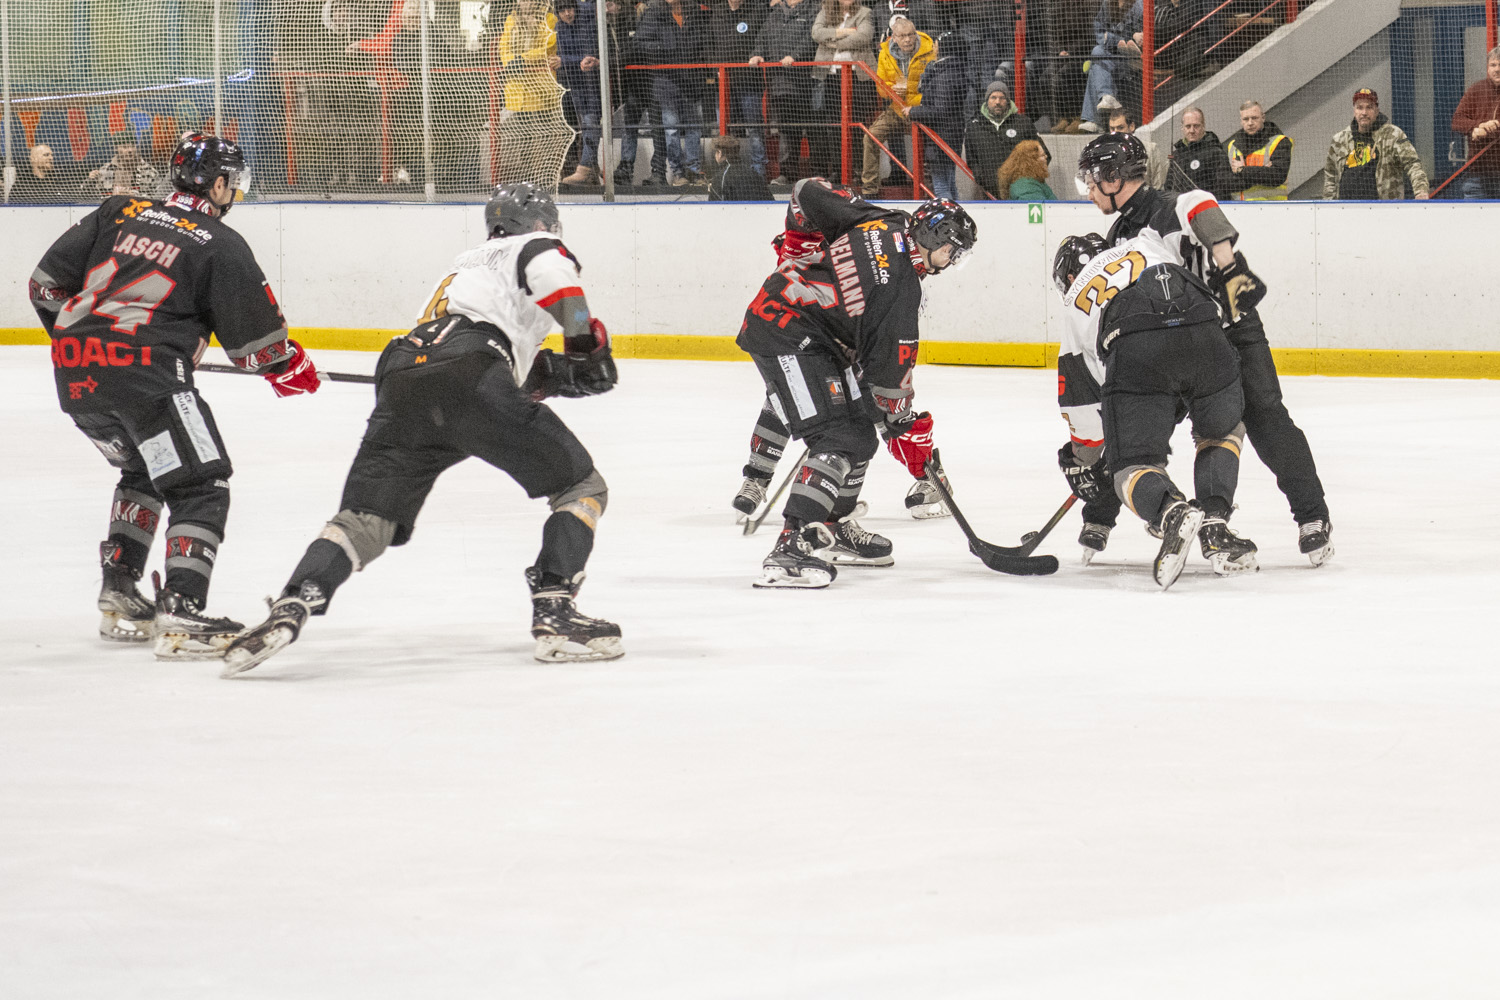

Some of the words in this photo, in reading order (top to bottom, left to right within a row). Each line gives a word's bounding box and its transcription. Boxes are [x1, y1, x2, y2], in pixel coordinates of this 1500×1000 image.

[140, 209, 213, 241] Reifen24.de
[869, 230, 891, 285] Reifen24.de
[1074, 250, 1147, 317] 32
[276, 357, 311, 383] CC
